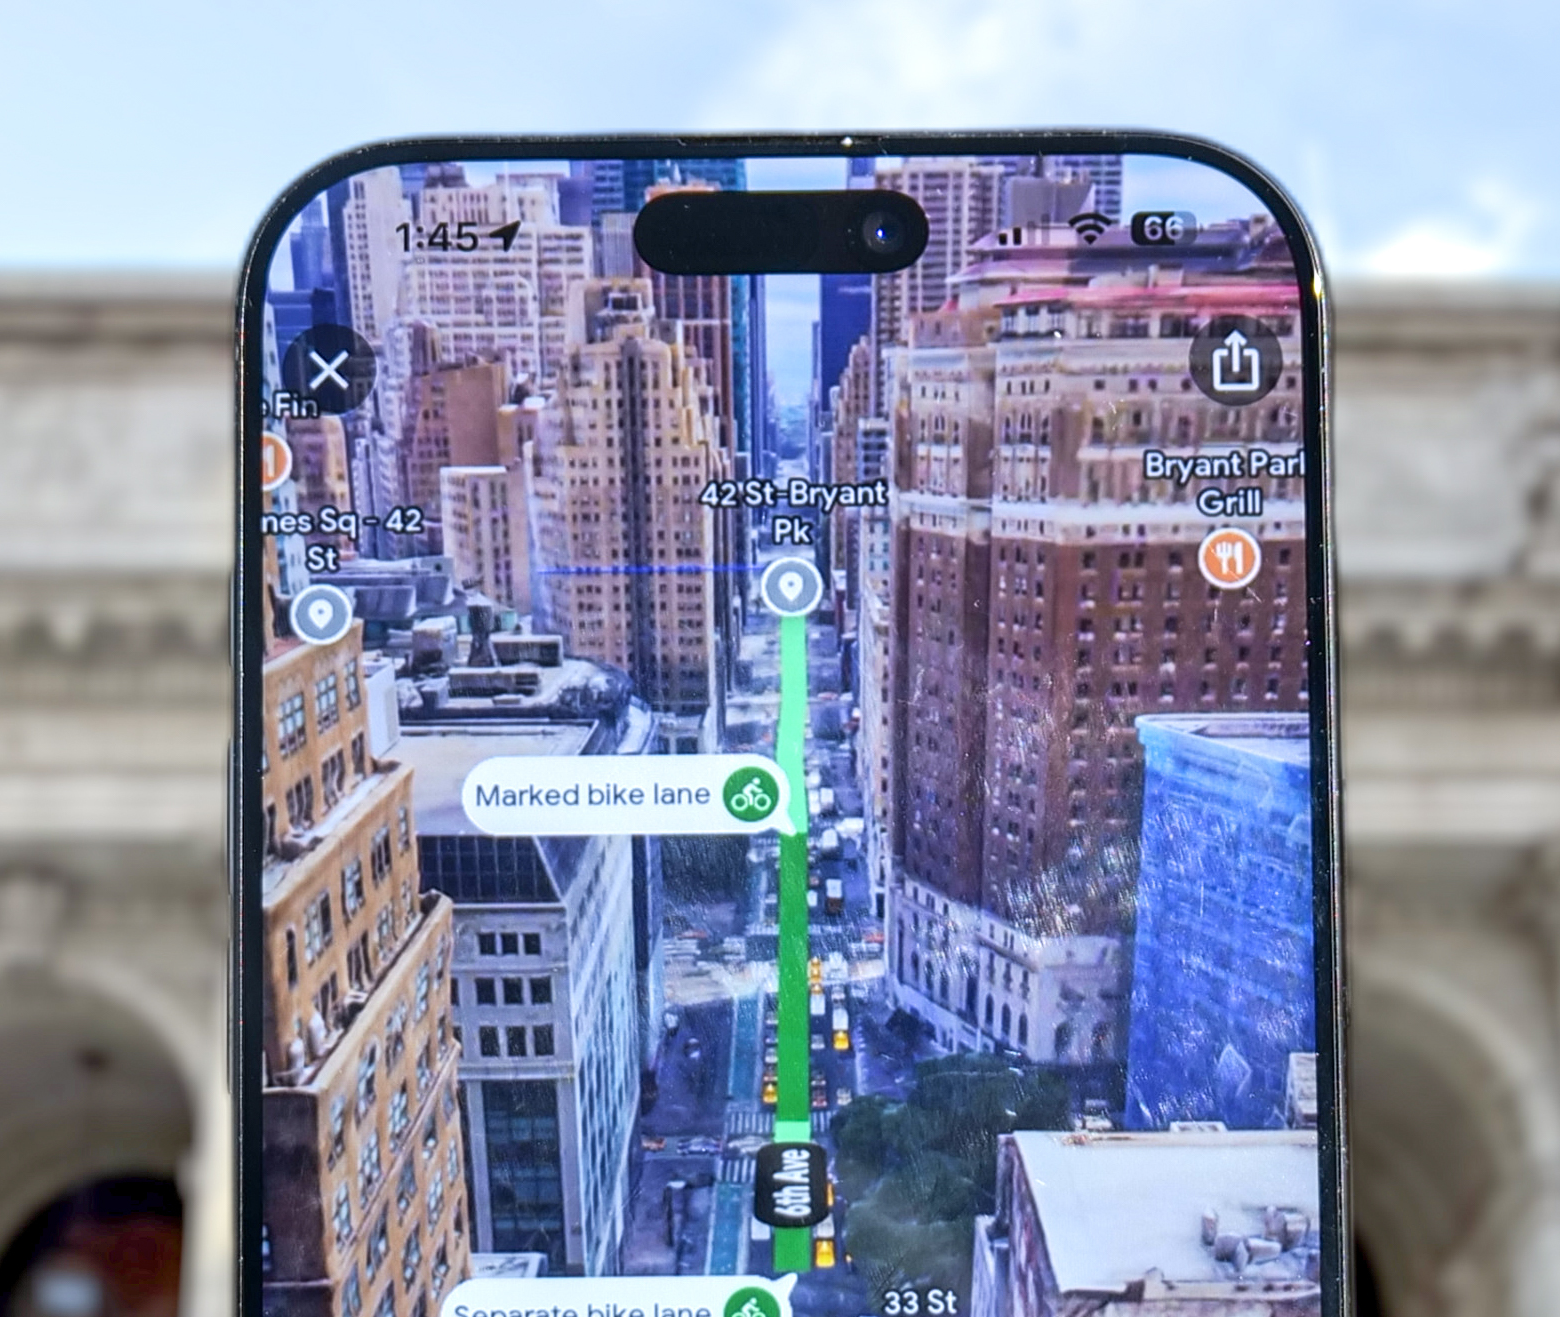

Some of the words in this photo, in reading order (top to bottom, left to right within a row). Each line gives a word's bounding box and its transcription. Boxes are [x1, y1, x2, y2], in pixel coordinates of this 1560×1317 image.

[396, 222, 479, 252] 1:45
[1143, 215, 1185, 241] 66
[1146, 452, 1242, 484] Bryant
[701, 482, 737, 506] 42
[1199, 489, 1261, 515] Grill
[320, 508, 357, 539] Sq
[385, 509, 423, 533] 42
[774, 517, 811, 544] Pk
[308, 546, 338, 571] St
[476, 783, 580, 807] Marked
[588, 783, 645, 806] bike
[654, 783, 711, 805] lane
[772, 1148, 811, 1184] Ave
[772, 1185, 812, 1217] 6th
[885, 1290, 919, 1315] 33
[927, 1288, 957, 1314] St
